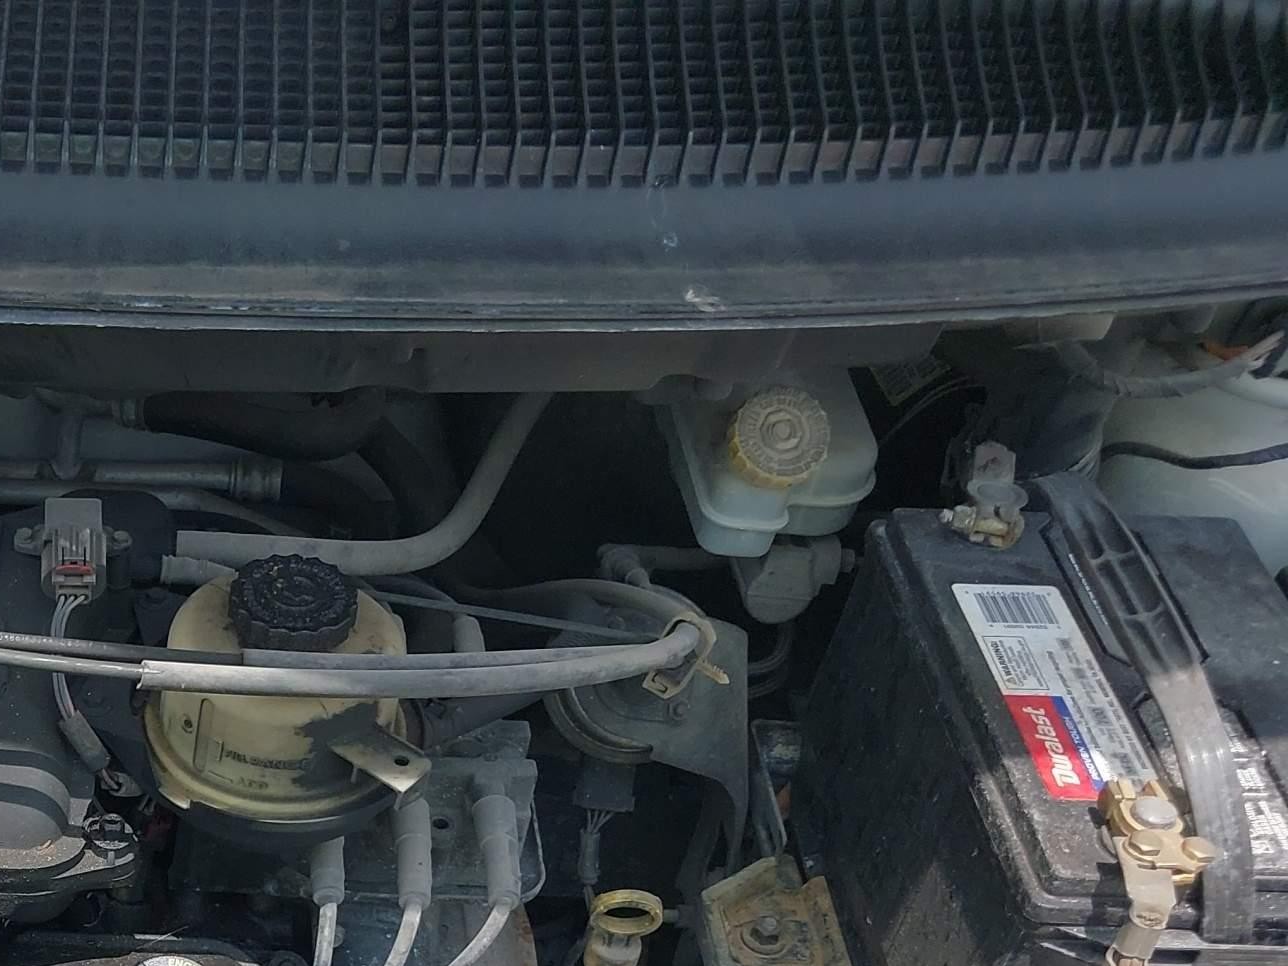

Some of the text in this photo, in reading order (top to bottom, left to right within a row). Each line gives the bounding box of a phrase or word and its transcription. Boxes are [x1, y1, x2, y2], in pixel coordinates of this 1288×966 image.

[1022, 706, 1081, 788] Duralast
[1063, 715, 1081, 747] TOUGH
[1079, 746, 1101, 781] PROVEN
